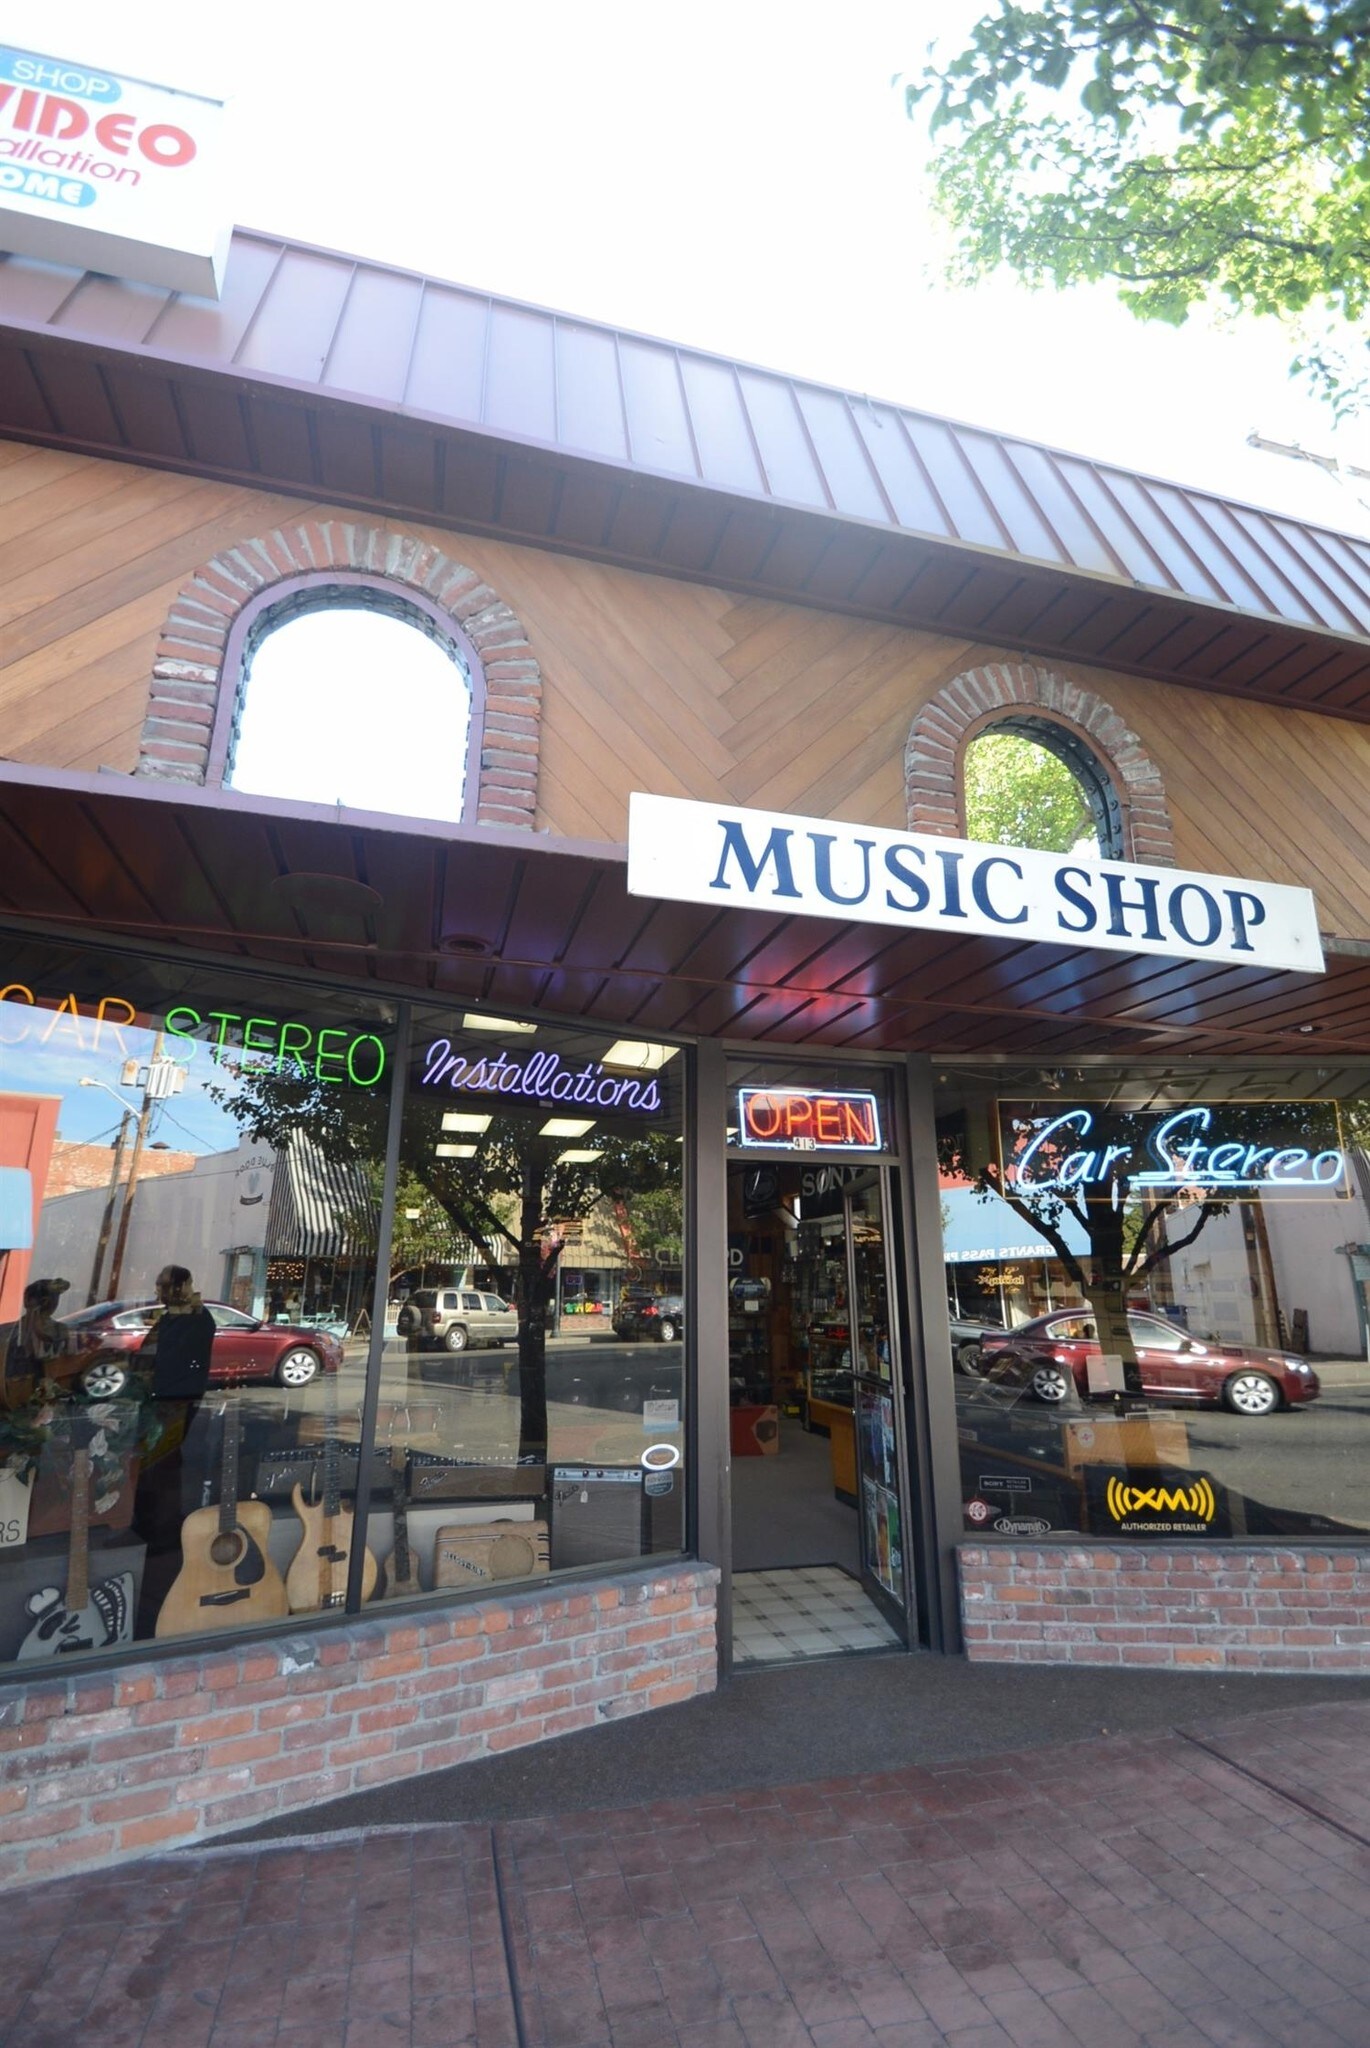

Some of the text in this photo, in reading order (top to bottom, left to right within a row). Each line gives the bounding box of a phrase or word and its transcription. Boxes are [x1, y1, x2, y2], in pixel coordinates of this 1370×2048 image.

[12, 60, 110, 98] SHOP
[709, 818, 1266, 951] MUSIC SHOP
[0, 984, 385, 1086] CAR STEREO
[422, 1039, 661, 1111] Installations
[749, 1092, 875, 1143] OPEN
[793, 1138, 816, 1149] 413
[1017, 1107, 1344, 1190] Car Stereo
[802, 1165, 859, 1197] SONY
[1131, 1487, 1191, 1511] XM
[1121, 1522, 1207, 1532] AUTHORIZED RETAILER
